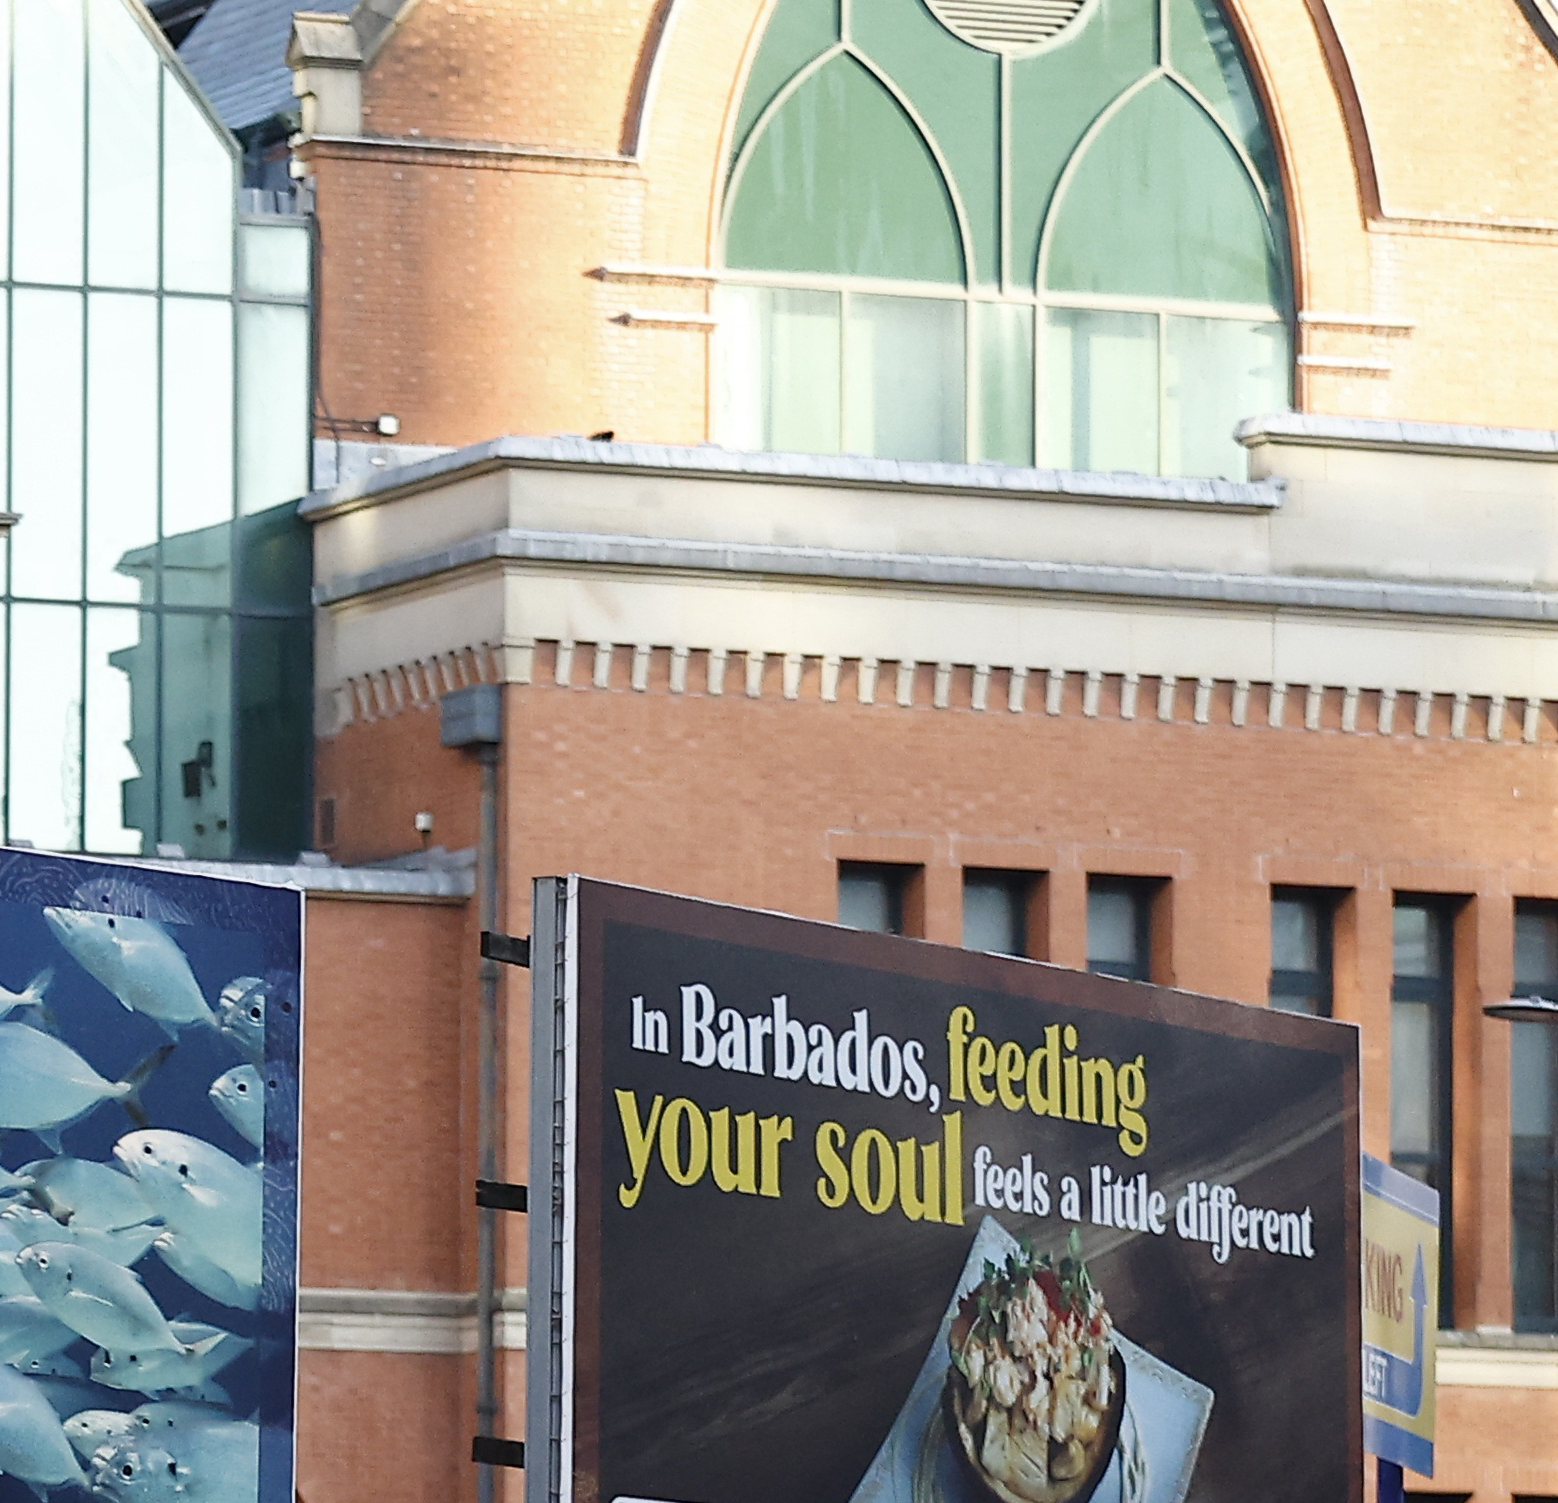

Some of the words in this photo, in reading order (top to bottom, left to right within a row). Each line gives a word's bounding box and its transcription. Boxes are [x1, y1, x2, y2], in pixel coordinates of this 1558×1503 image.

[631, 994, 669, 1056] In
[680, 983, 942, 1114] Barbados,
[946, 1005, 1150, 1158] feeding
[613, 1088, 794, 1210] your
[815, 1110, 966, 1227] soul
[973, 1145, 1051, 1219] feels
[1060, 1175, 1081, 1222] a
[1089, 1165, 1167, 1237] little
[1175, 1181, 1315, 1265] different
